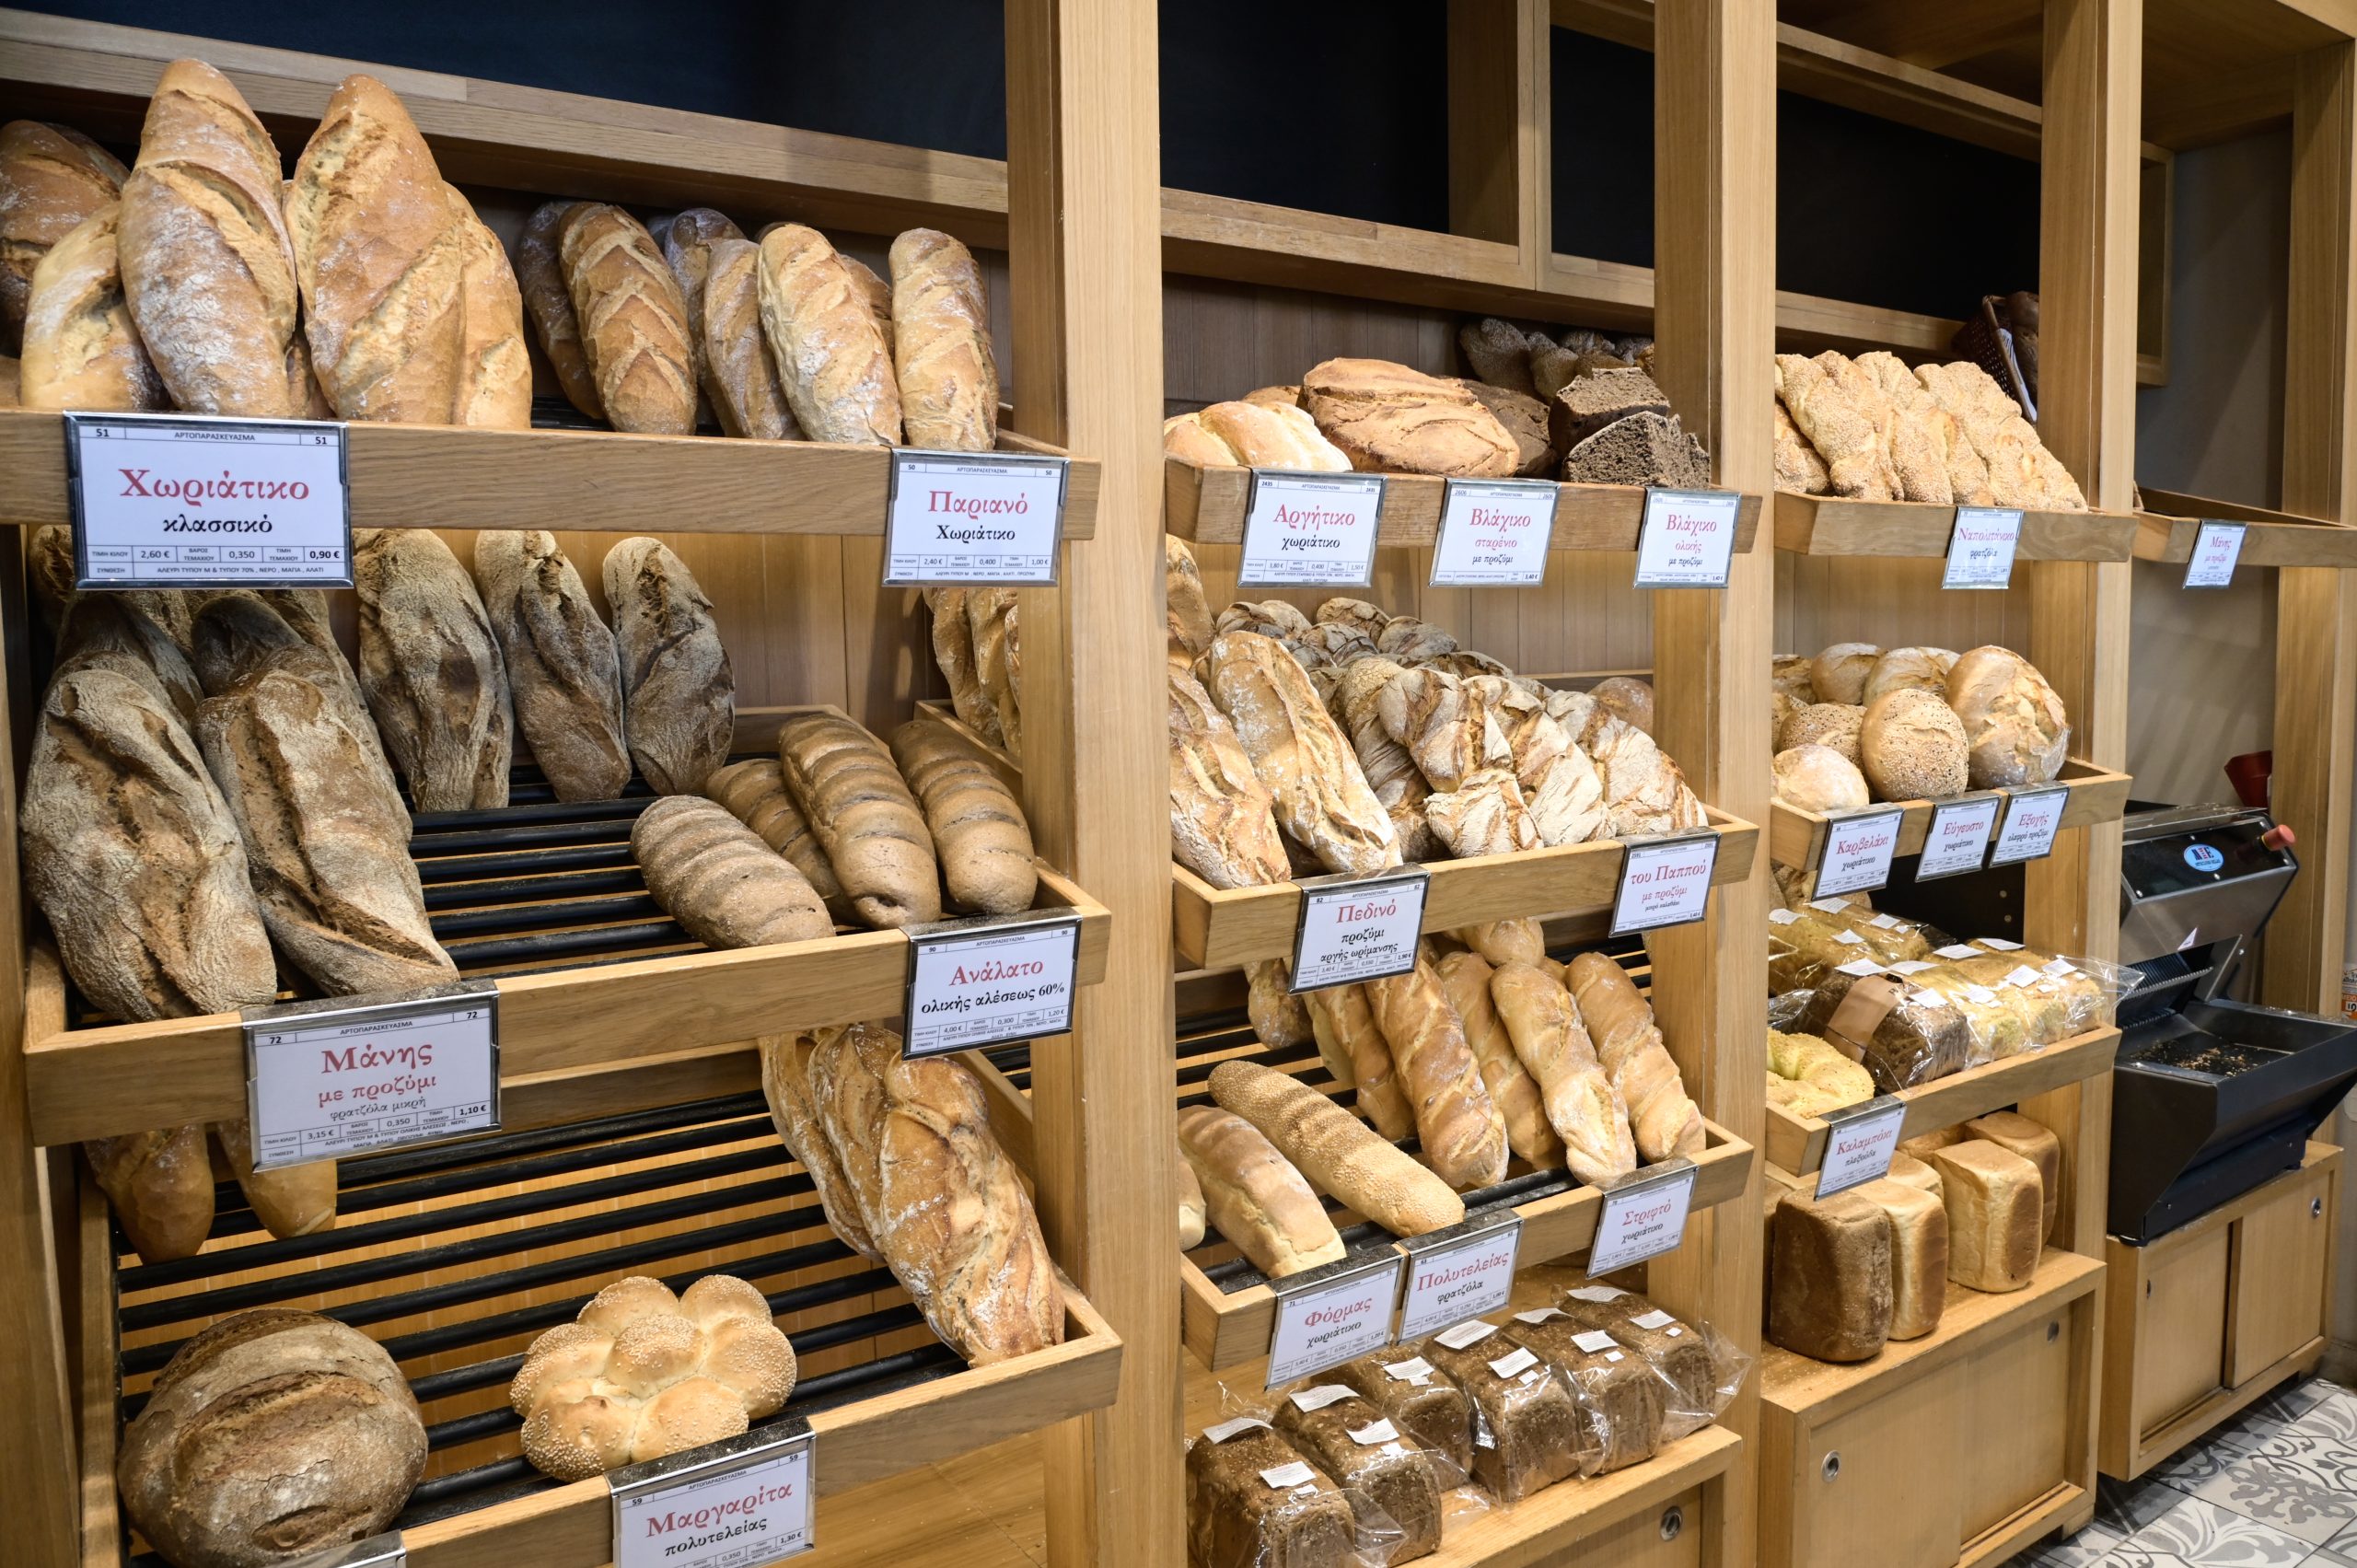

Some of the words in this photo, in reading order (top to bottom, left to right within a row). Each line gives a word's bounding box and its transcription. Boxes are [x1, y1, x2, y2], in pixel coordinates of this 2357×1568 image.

[96, 428, 110, 437] 51
[174, 432, 256, 442] ΑΡΤΟΠΑΡΑΣΚΕΥΑΣΜΑ
[315, 436, 328, 445] 51
[119, 469, 309, 506] Χωριάτικο
[928, 491, 1028, 520] Παριανό
[163, 514, 273, 533] κλασσικό
[1273, 504, 1355, 530] Αργήτικο
[1469, 508, 1531, 532] Βλάχικο
[1666, 515, 1717, 537] Βλάχικο
[936, 525, 1016, 543] Χωριάτικο
[1282, 534, 1341, 551] χωριάτικο
[1475, 537, 1517, 551] σταρένιο
[141, 550, 162, 559] 2,60
[163, 550, 170, 559] €
[228, 551, 255, 560] 0,350
[309, 550, 331, 560] 0,90
[333, 551, 340, 559] €
[1472, 556, 1482, 565] με
[1484, 554, 1514, 565] προζύμι
[1668, 558, 1677, 566] με
[1678, 557, 1702, 567] προζύμι
[1943, 818, 1984, 837] Εύγευστο
[2018, 810, 2049, 828] Εξοχής
[1837, 833, 1889, 855] Καρβελάκι
[1631, 872, 1652, 885] του
[1655, 859, 1706, 881] Παππού
[1642, 891, 1652, 904] με
[1655, 885, 1688, 900] προζύμι
[1337, 899, 1397, 923] Πεδινό
[1341, 927, 1385, 946] προζύμι
[1320, 948, 1348, 964] αργής
[1351, 942, 1399, 958] ωρίμανσης
[948, 960, 1044, 986] Ανάλατο
[921, 995, 971, 1014] ολικής
[975, 988, 1036, 1006] αλέσεως
[1039, 981, 1064, 996] 60%
[467, 1011, 478, 1019] 72
[341, 1020, 413, 1036] ΑΡΤΟΠΑΡΑΣΚΕΥΑΣΜΑ
[270, 1036, 282, 1044] 72
[321, 1043, 434, 1074] Μάνης
[319, 1090, 343, 1108] με
[352, 1074, 436, 1100] προζύμι
[331, 1104, 388, 1121] φρατζόλα
[392, 1097, 426, 1112] μικρή
[459, 1106, 479, 1116] 1,10
[387, 1118, 411, 1127] 0,350
[308, 1131, 327, 1140] 3,15
[1837, 1130, 1892, 1156] Καλαμπόκι
[1622, 1199, 1671, 1226] Στριφτό
[1621, 1223, 1664, 1244] χωριάτικο
[1417, 1252, 1509, 1292] Πολυτελείας
[1437, 1281, 1483, 1305] φρατζόλα
[1305, 1297, 1372, 1327] Φόρμας
[1306, 1321, 1362, 1349] χωριάτικο
[789, 1454, 798, 1462] 59
[632, 1498, 643, 1506] 59
[646, 1483, 793, 1538] Μαργαρίτα
[665, 1518, 767, 1556] πολυτελείας
[780, 1534, 795, 1544] 1,30
